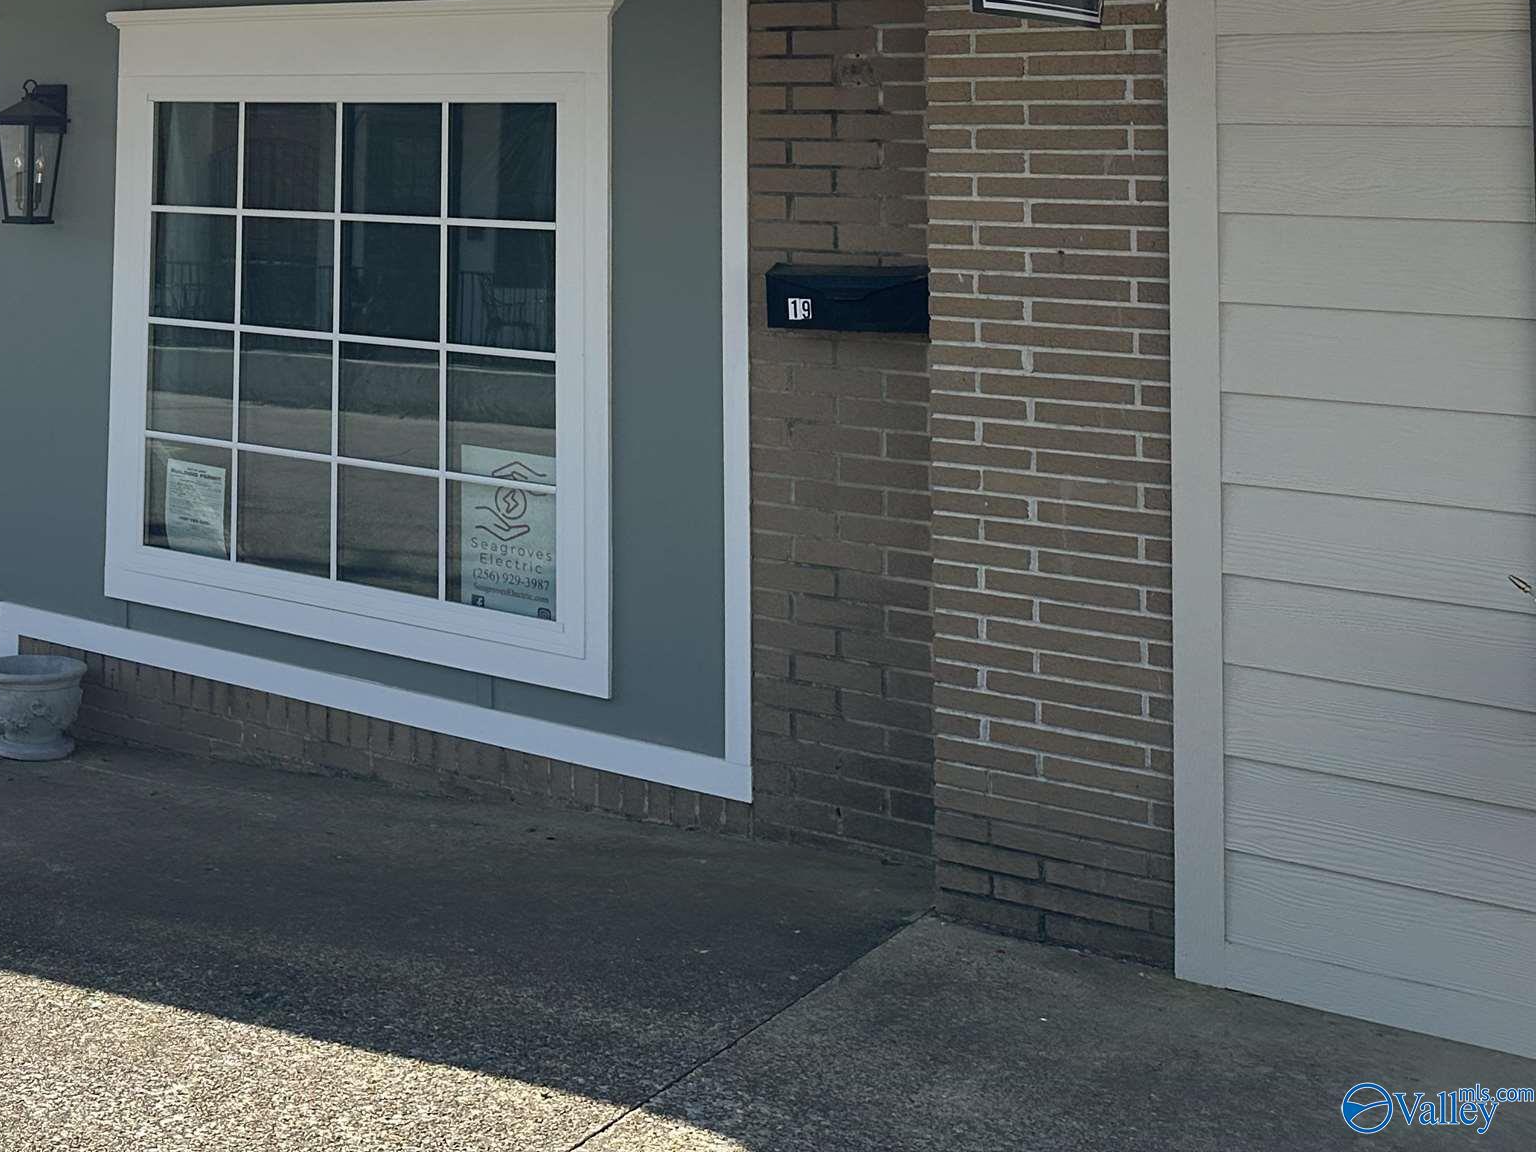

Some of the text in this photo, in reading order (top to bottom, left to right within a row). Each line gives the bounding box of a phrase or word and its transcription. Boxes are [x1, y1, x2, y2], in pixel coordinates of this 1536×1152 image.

[790, 299, 811, 320] 19
[471, 537, 552, 562] Seagroves
[480, 552, 543, 574] Electric
[473, 567, 550, 591] (256) 929-3987
